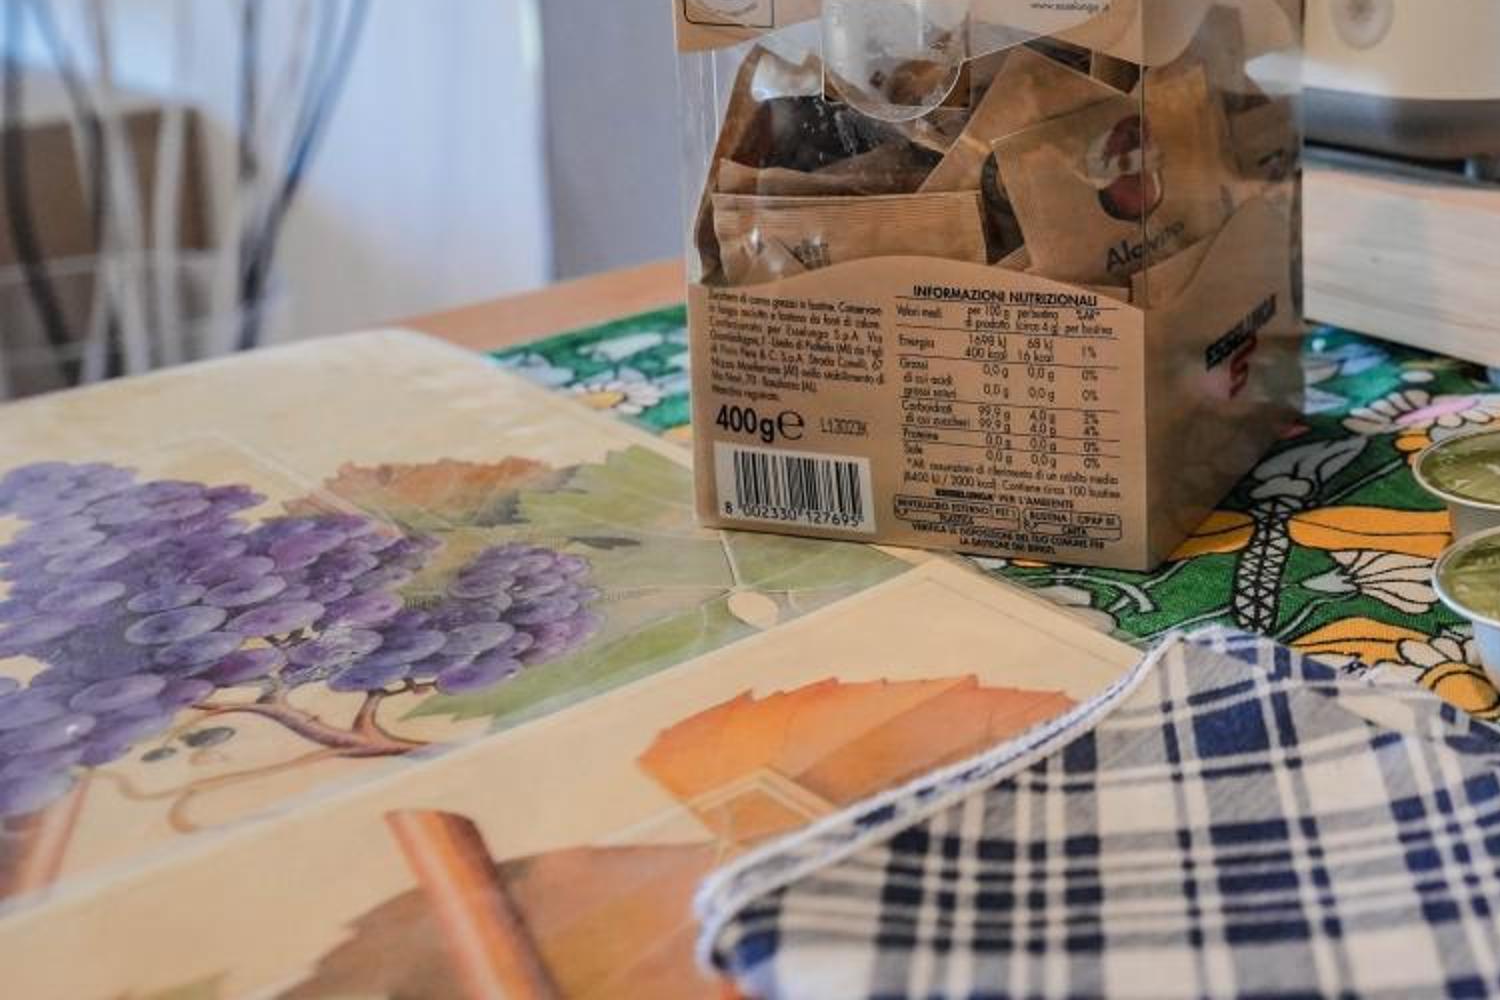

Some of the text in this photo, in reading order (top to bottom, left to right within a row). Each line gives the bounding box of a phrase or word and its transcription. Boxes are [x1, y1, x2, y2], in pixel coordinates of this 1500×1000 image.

[913, 285, 1098, 307] INFORMAZIONI NUTRIZIONALI
[743, 504, 798, 520] 002330
[807, 511, 860, 527] 127695
